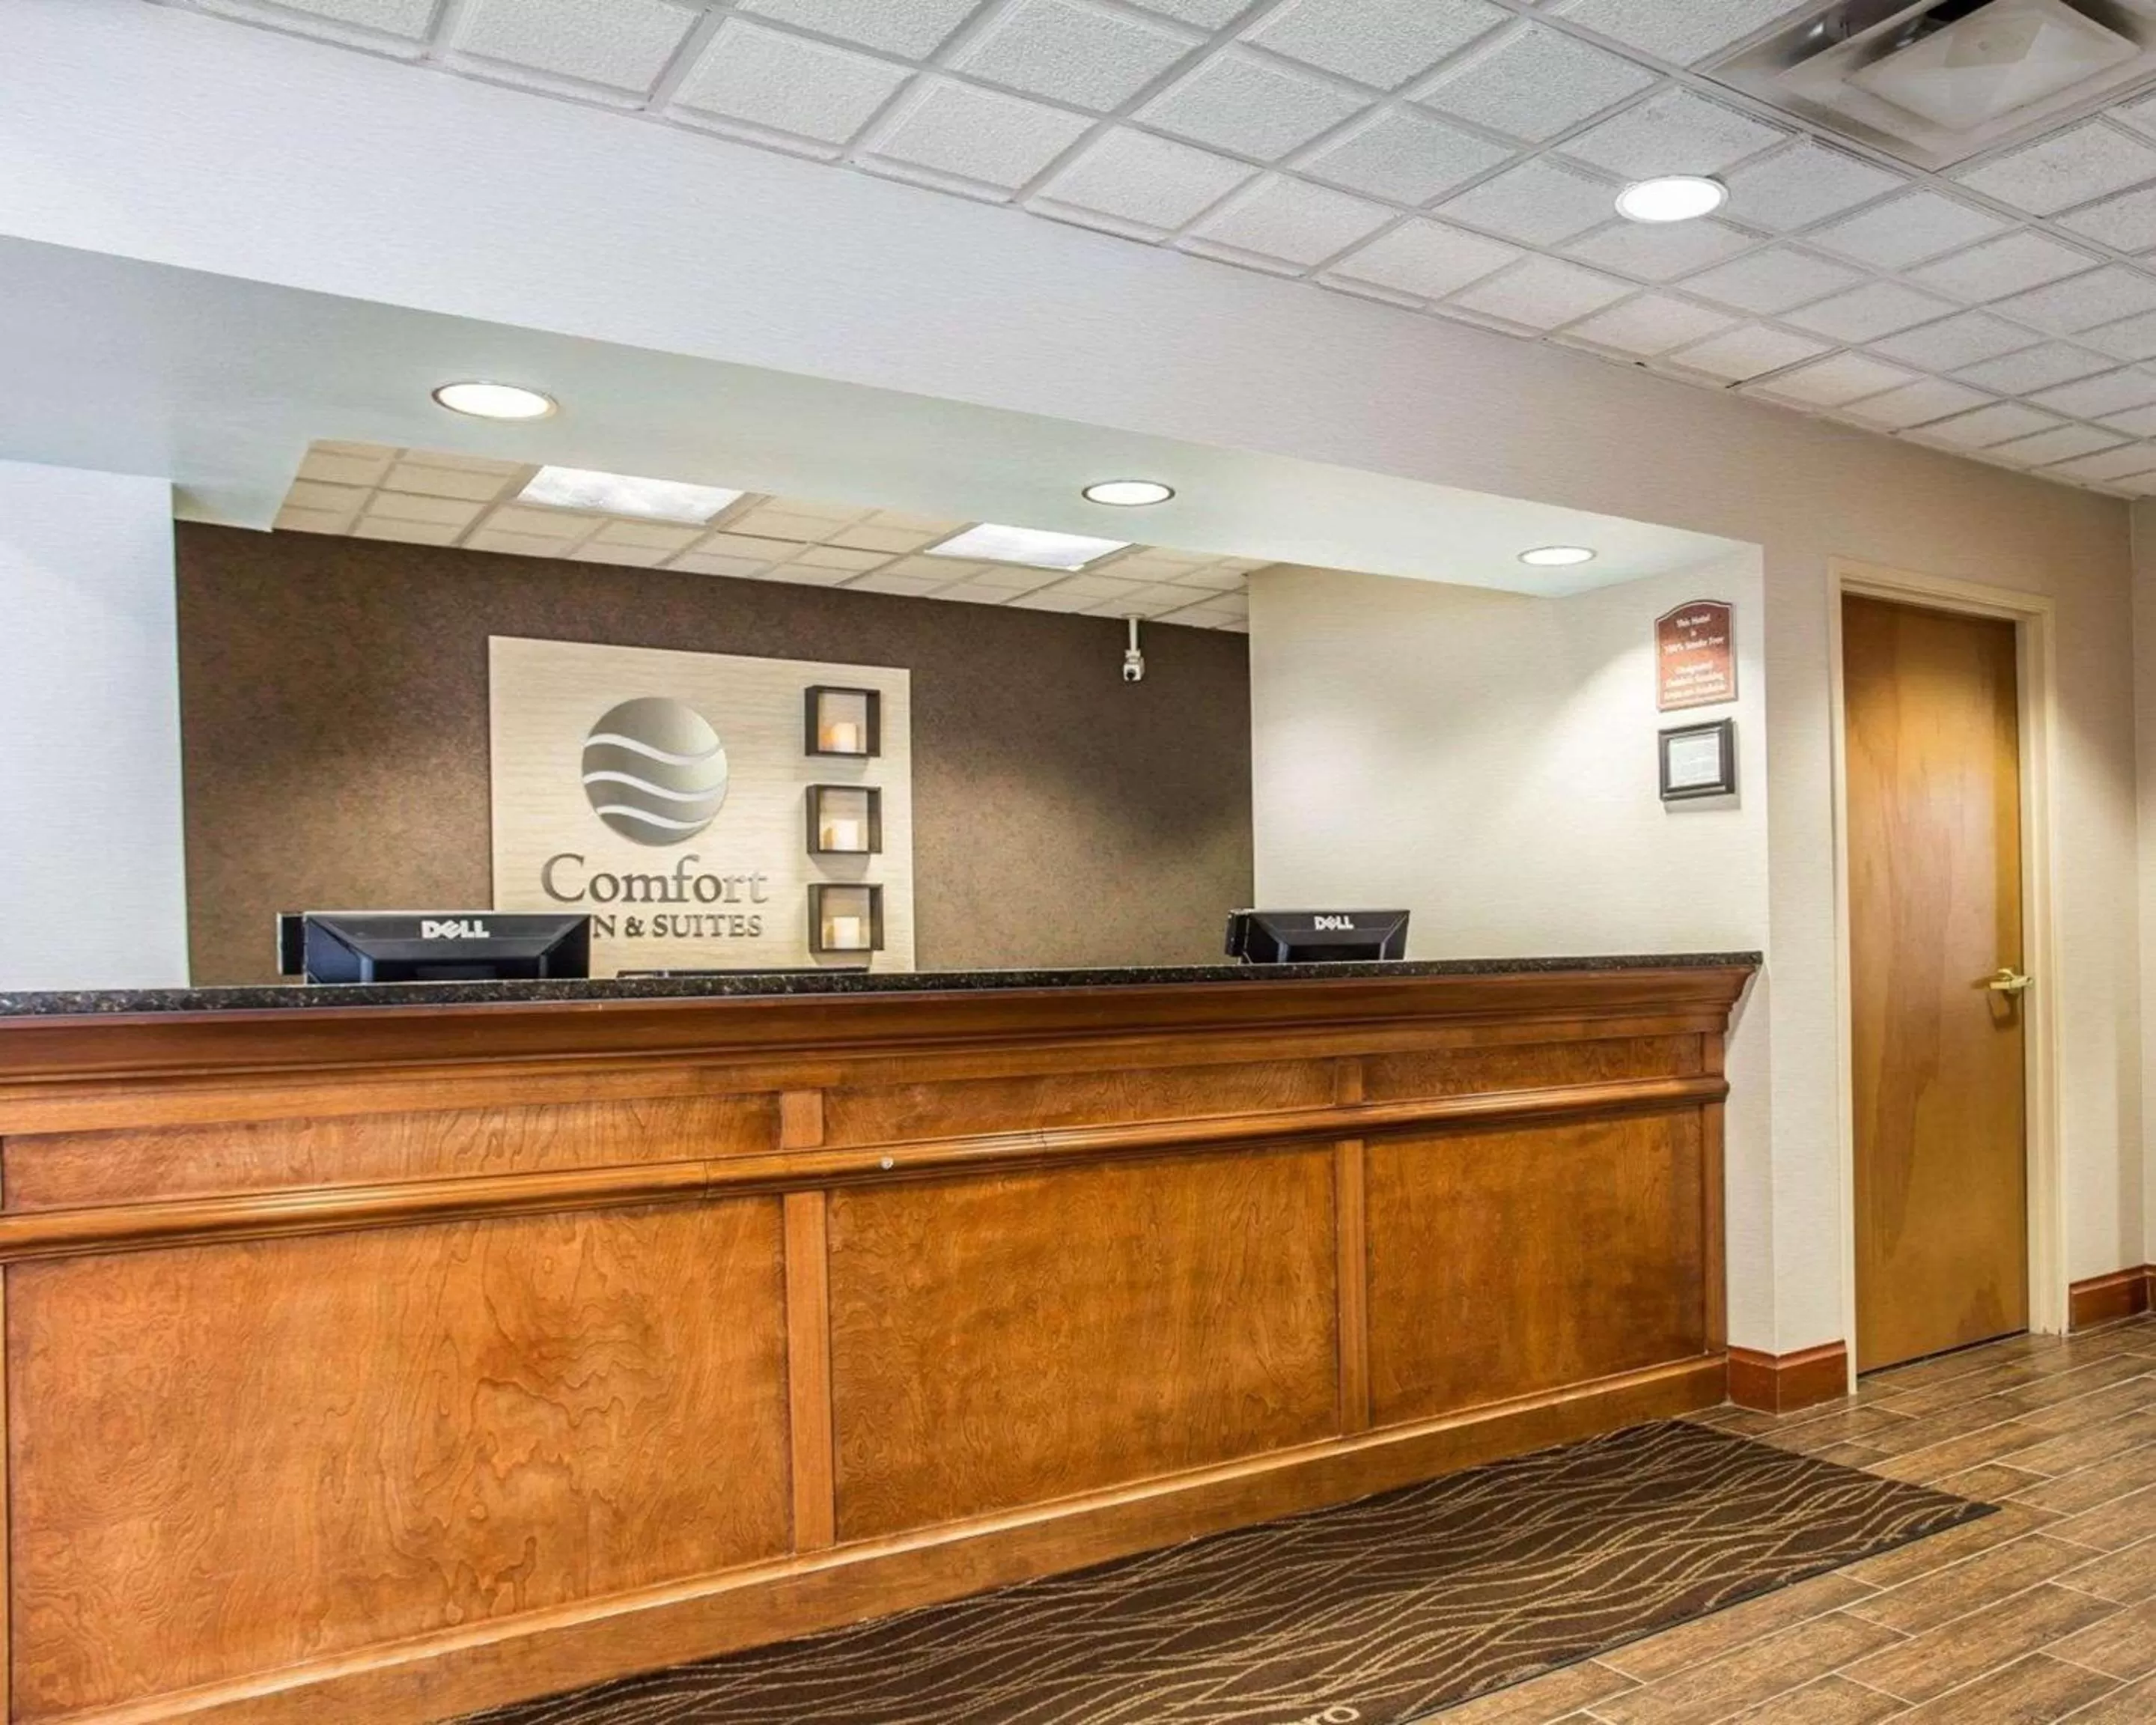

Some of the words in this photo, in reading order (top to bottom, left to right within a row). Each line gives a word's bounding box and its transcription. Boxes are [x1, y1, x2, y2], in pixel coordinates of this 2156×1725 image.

[540, 853, 769, 904] Comfort
[421, 920, 490, 940] DELL
[624, 916, 645, 937] &
[652, 913, 763, 937] SUITES
[1314, 915, 1354, 931] DELL
